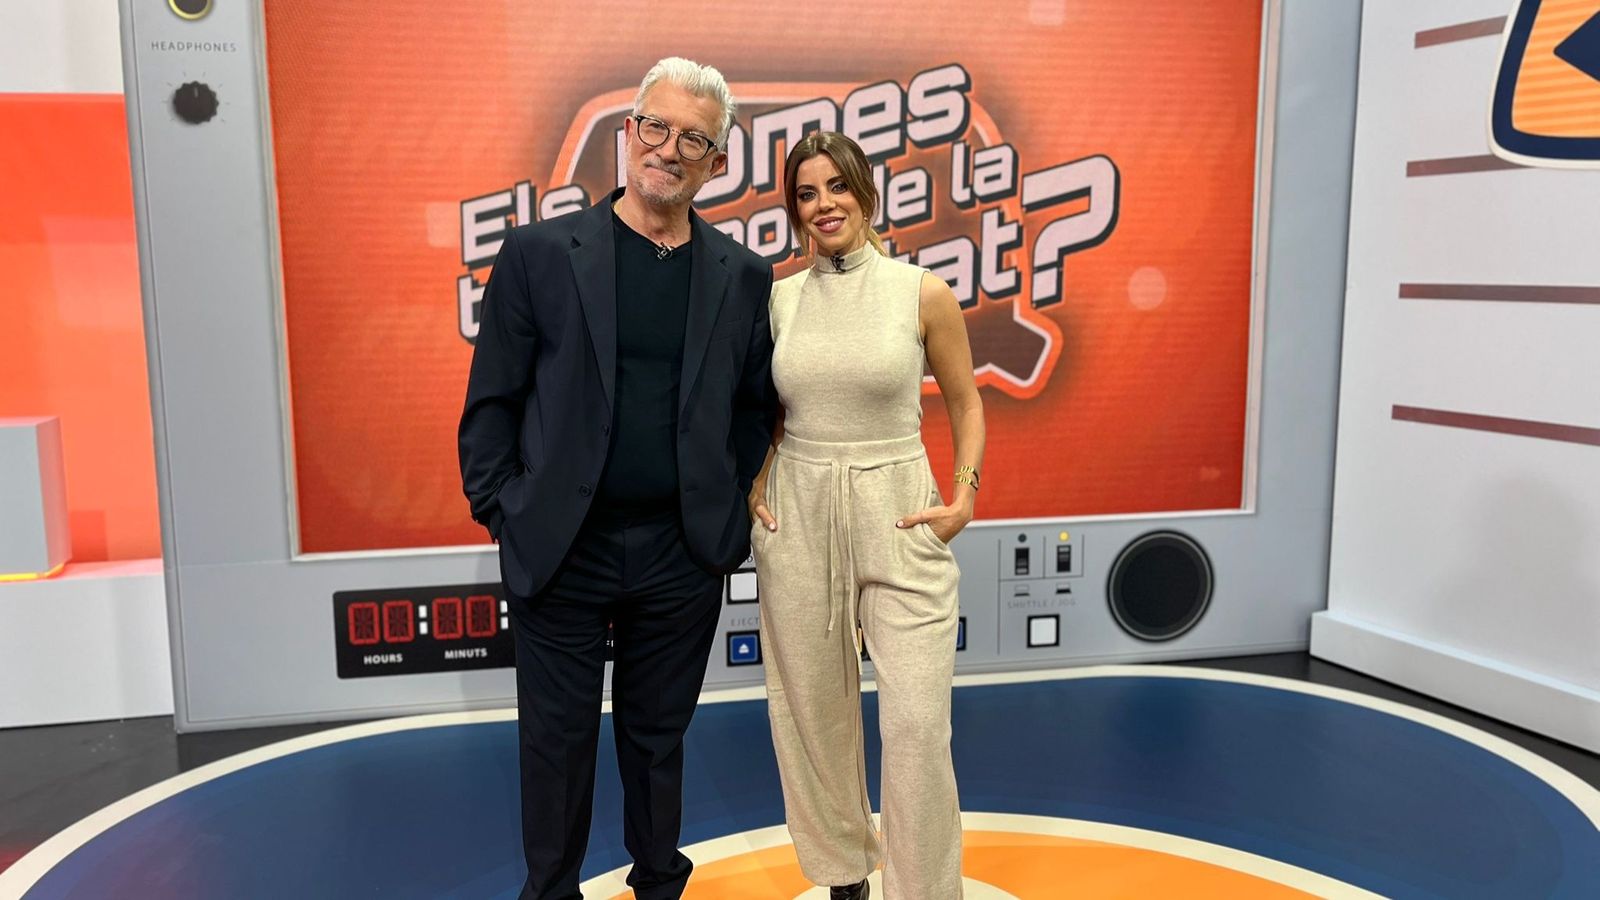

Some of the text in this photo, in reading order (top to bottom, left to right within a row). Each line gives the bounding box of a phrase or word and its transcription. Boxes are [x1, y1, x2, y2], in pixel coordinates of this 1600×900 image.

[150, 41, 238, 53] HEADPHONES
[951, 142, 1014, 204] la
[363, 653, 403, 665] HOURS
[444, 647, 488, 660] MINUTS
